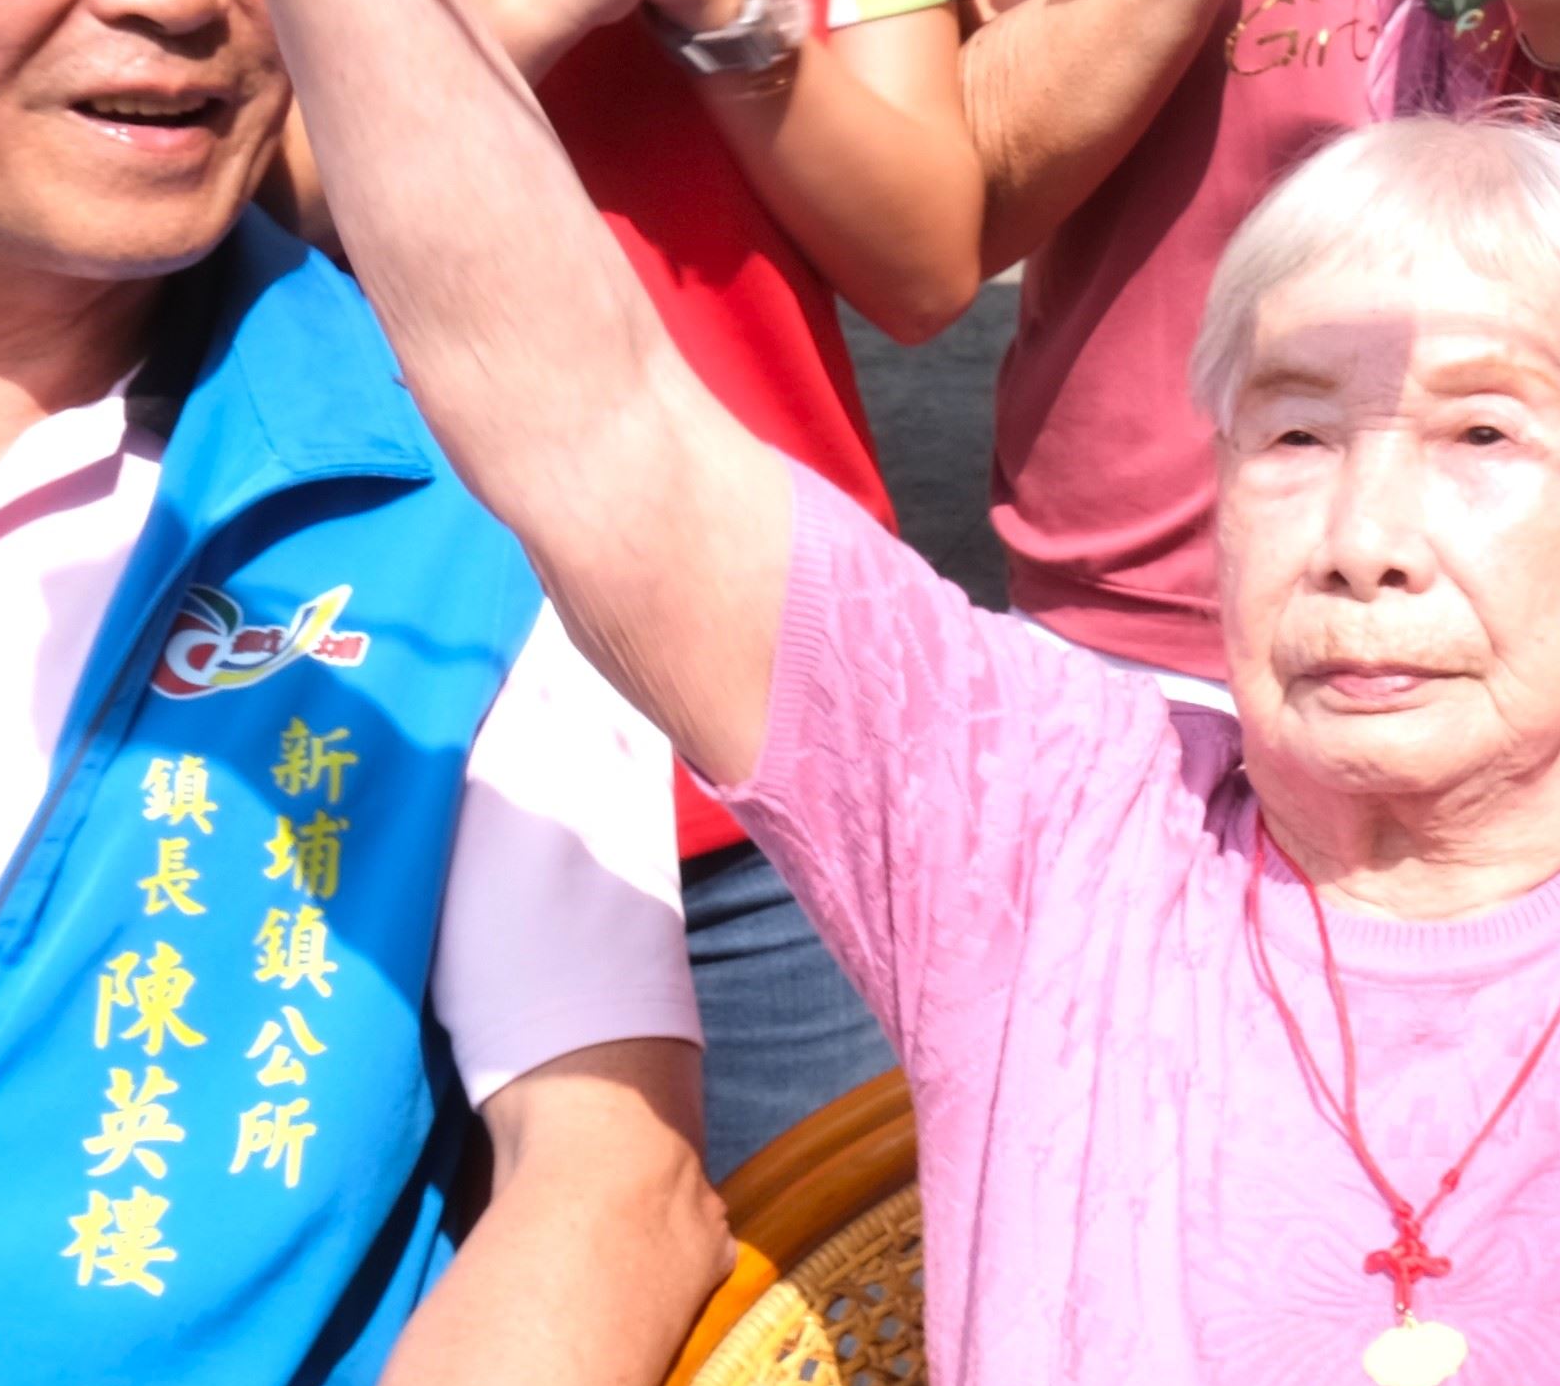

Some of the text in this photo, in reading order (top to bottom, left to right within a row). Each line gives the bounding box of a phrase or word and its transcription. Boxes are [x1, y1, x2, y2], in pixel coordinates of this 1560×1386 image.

[228, 715, 359, 1189] 新埔鎮公所
